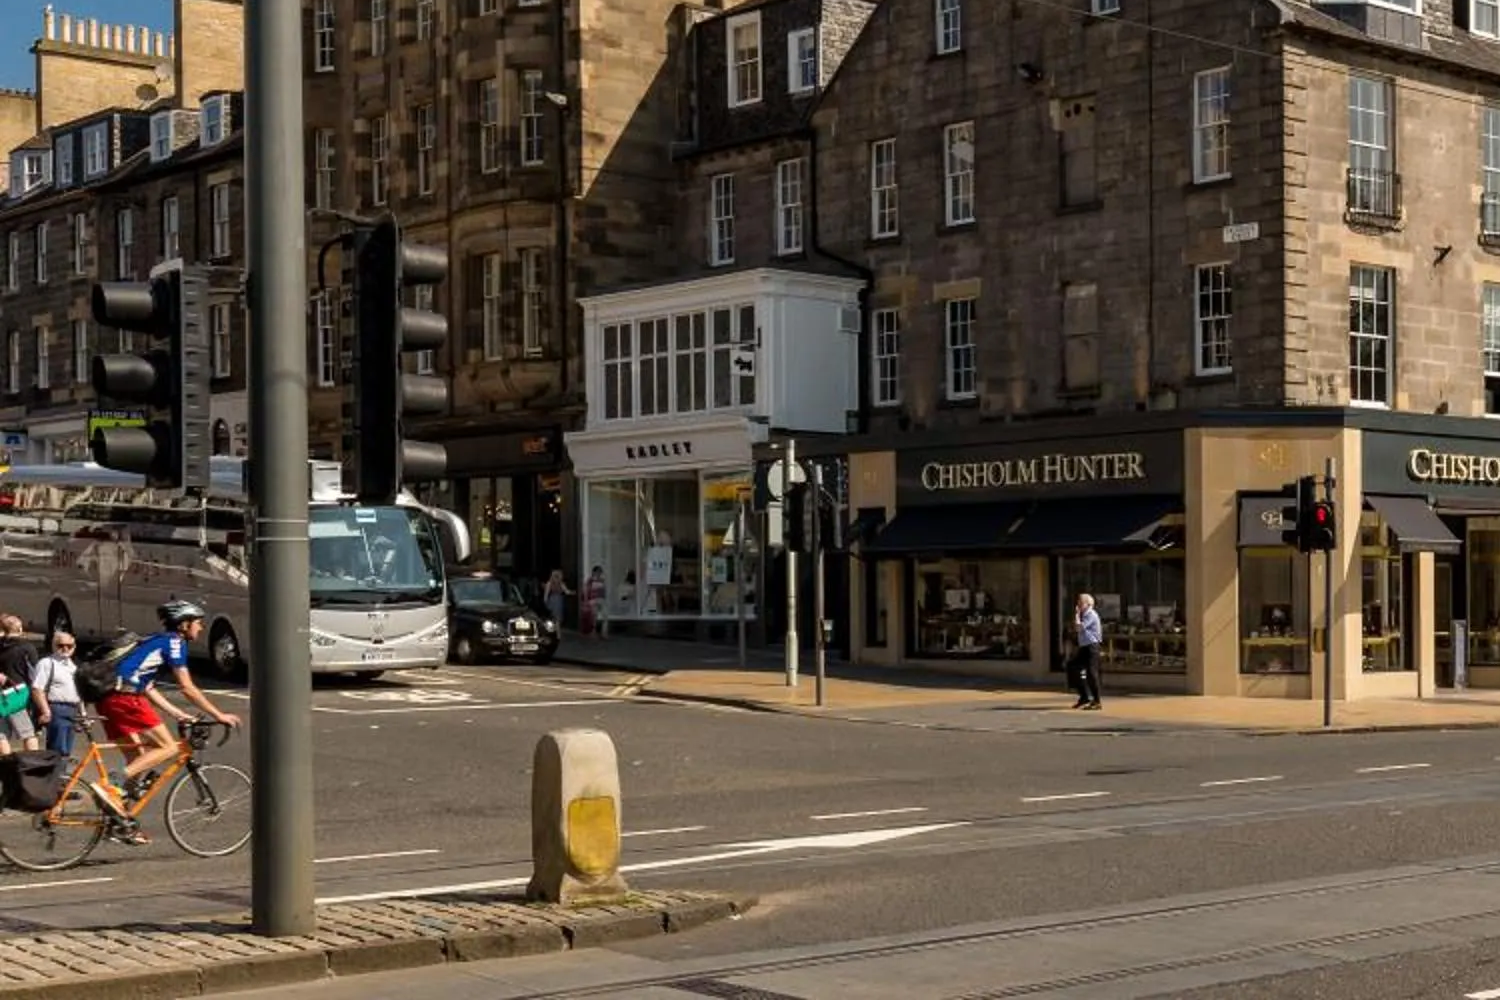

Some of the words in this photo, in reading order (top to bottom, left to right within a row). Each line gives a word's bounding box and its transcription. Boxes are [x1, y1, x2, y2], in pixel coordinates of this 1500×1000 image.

[626, 441, 692, 459] RADLEY
[920, 459, 1040, 491] CHISHOLM
[1042, 452, 1145, 484] HUNTER
